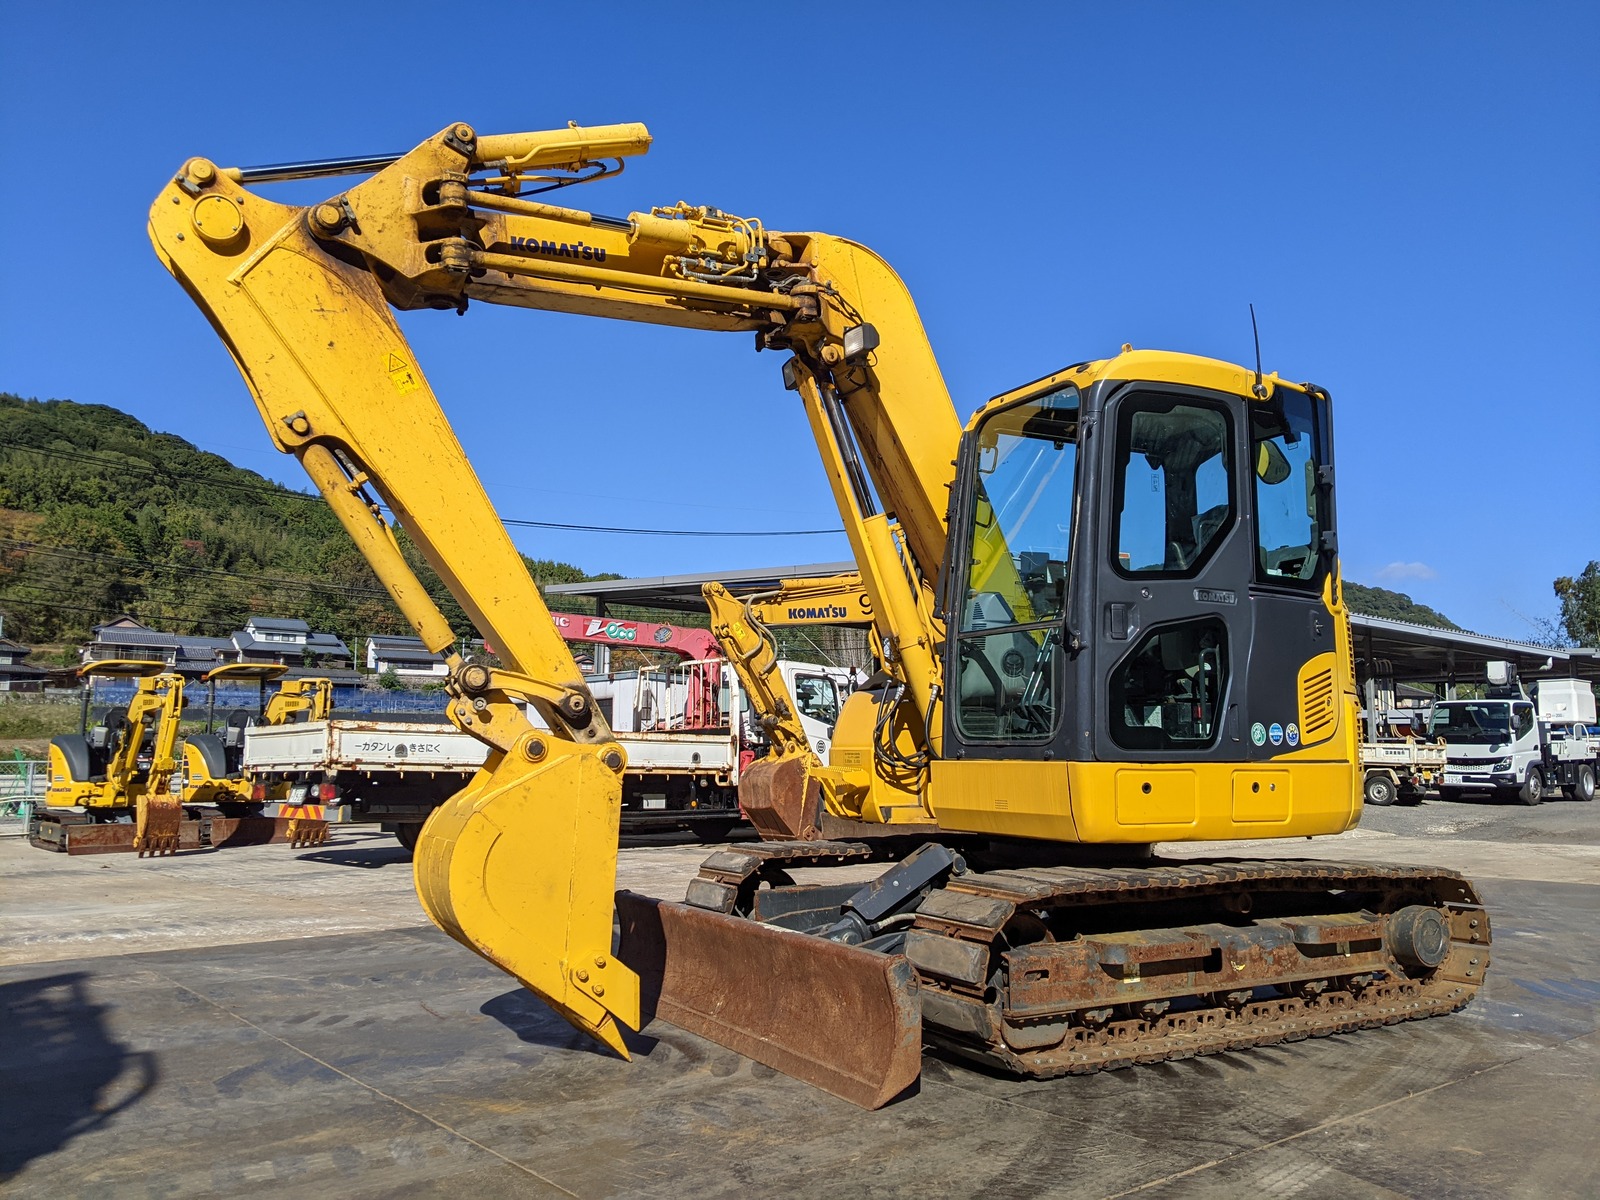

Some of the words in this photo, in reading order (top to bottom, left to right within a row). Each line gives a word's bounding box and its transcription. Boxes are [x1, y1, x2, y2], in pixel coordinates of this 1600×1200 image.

[510, 236, 606, 262] KOMATSU
[788, 604, 847, 619] KOMATSU
[859, 593, 873, 615] 9
[552, 616, 570, 627] IC
[409, 743, 441, 753] きさにく
